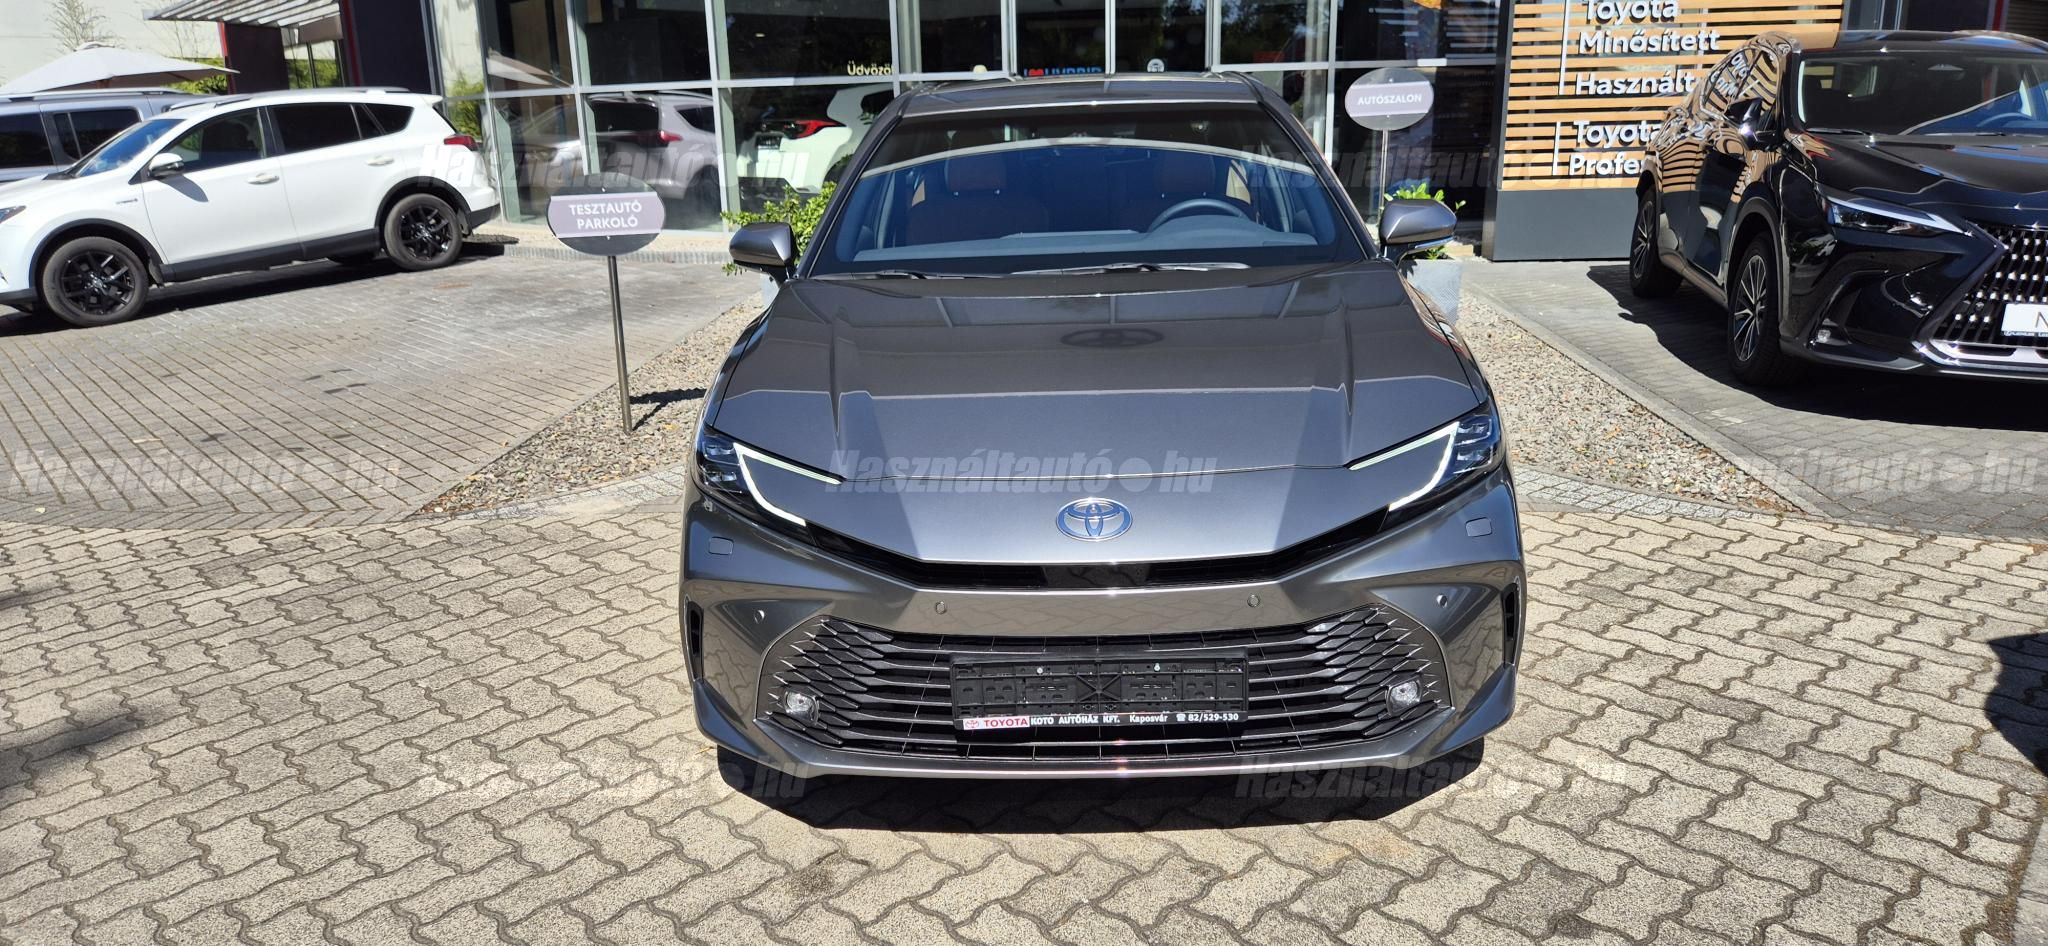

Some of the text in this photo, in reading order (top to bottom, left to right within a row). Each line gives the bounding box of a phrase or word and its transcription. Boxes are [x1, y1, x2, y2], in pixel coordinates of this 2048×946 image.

[1582, 0, 1678, 25] Toyota
[1579, 28, 1721, 54] Minősített
[1575, 70, 1695, 95] Használt
[1358, 93, 1422, 105] AUTÓSZALON
[1569, 152, 1645, 175] Profe
[568, 199, 642, 216] TESZTAUTÓ
[577, 214, 638, 230] PARKOLÓ
[984, 718, 1028, 728] TOYOTA
[1058, 714, 1099, 724] AUTÓHÁZ
[1102, 714, 1120, 723] KFT.
[1129, 714, 1168, 724] Kaposvár
[1188, 713, 1239, 723] 82/529-530
